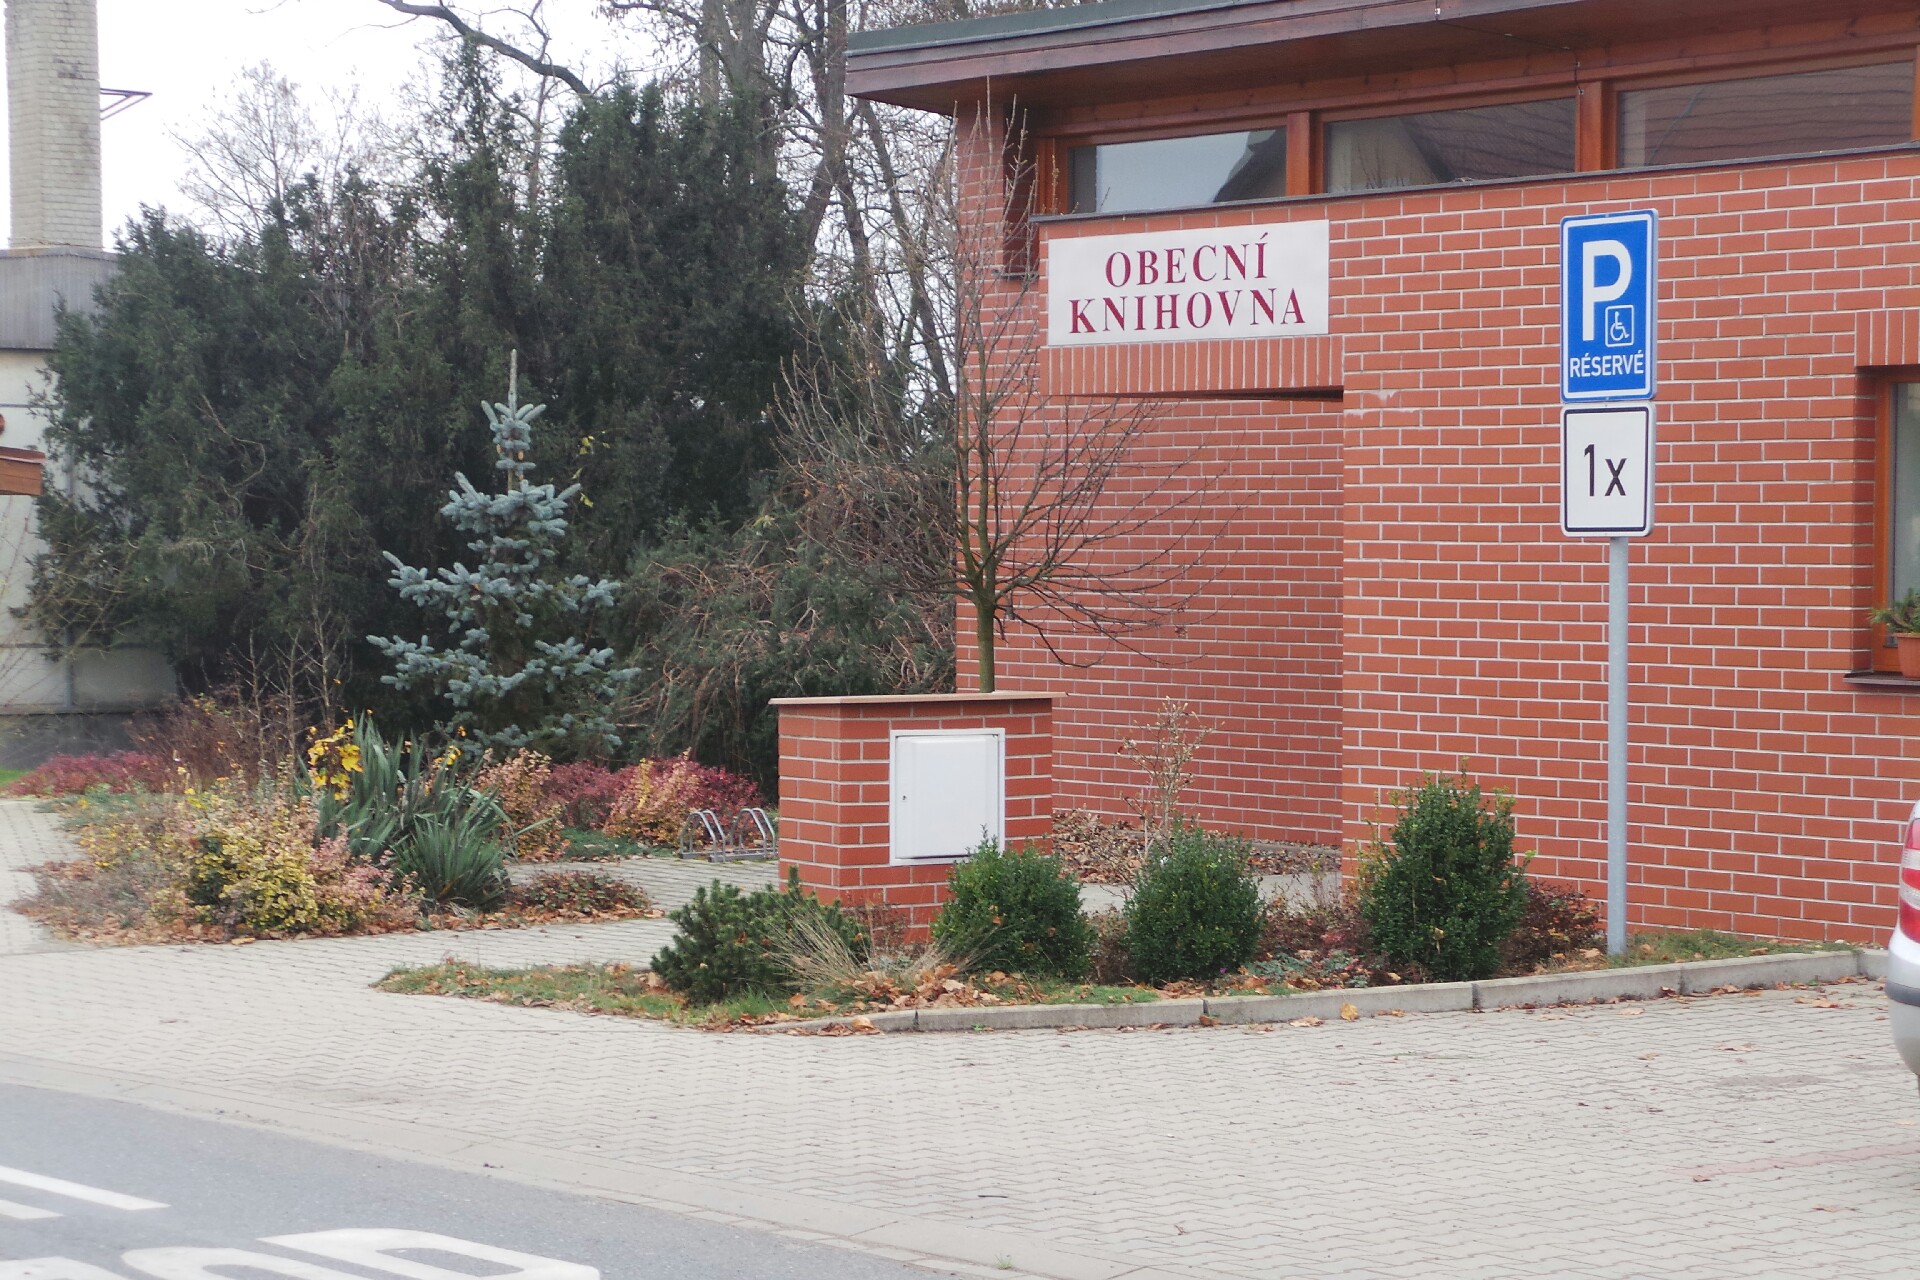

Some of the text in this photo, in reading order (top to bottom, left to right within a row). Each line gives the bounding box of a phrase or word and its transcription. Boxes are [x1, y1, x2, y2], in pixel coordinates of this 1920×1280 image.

[1105, 232, 1268, 287] OBECNÍ
[1069, 288, 1306, 334] KNIHOVNA
[1582, 239, 1632, 341] P
[1569, 350, 1644, 378] RÉSERVÉ
